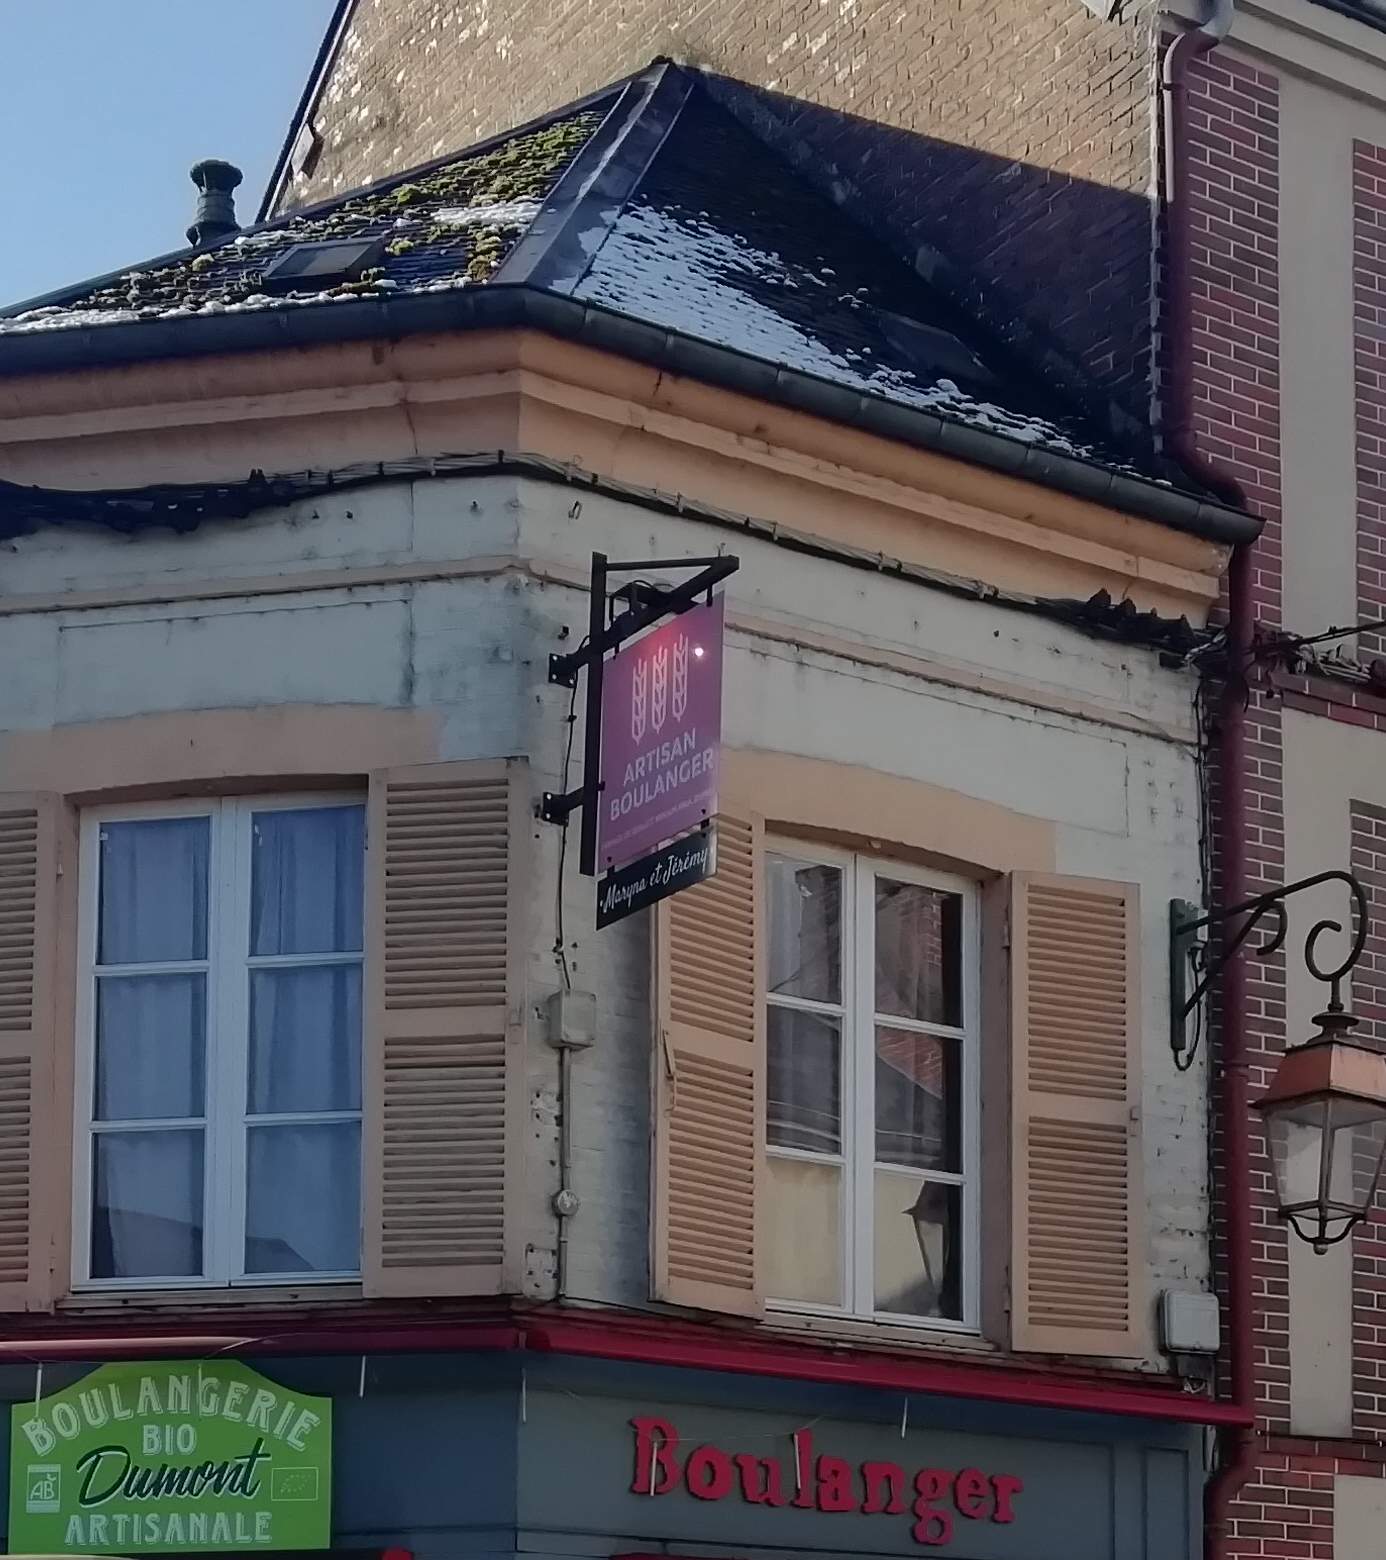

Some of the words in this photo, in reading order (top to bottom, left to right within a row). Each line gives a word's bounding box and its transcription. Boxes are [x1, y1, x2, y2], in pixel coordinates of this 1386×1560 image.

[610, 747, 714, 821] BOULANGER
[623, 727, 696, 786] ARTISAN
[600, 876, 649, 914] Maryna
[649, 861, 664, 888] et
[663, 846, 708, 885] Jérémy
[21, 1374, 322, 1457] BOULANGERIE
[142, 1423, 197, 1456] BIO
[75, 1436, 272, 1509] Dumont
[630, 1415, 1023, 1545] Boulanger
[65, 1511, 273, 1546] ARTISANALE
